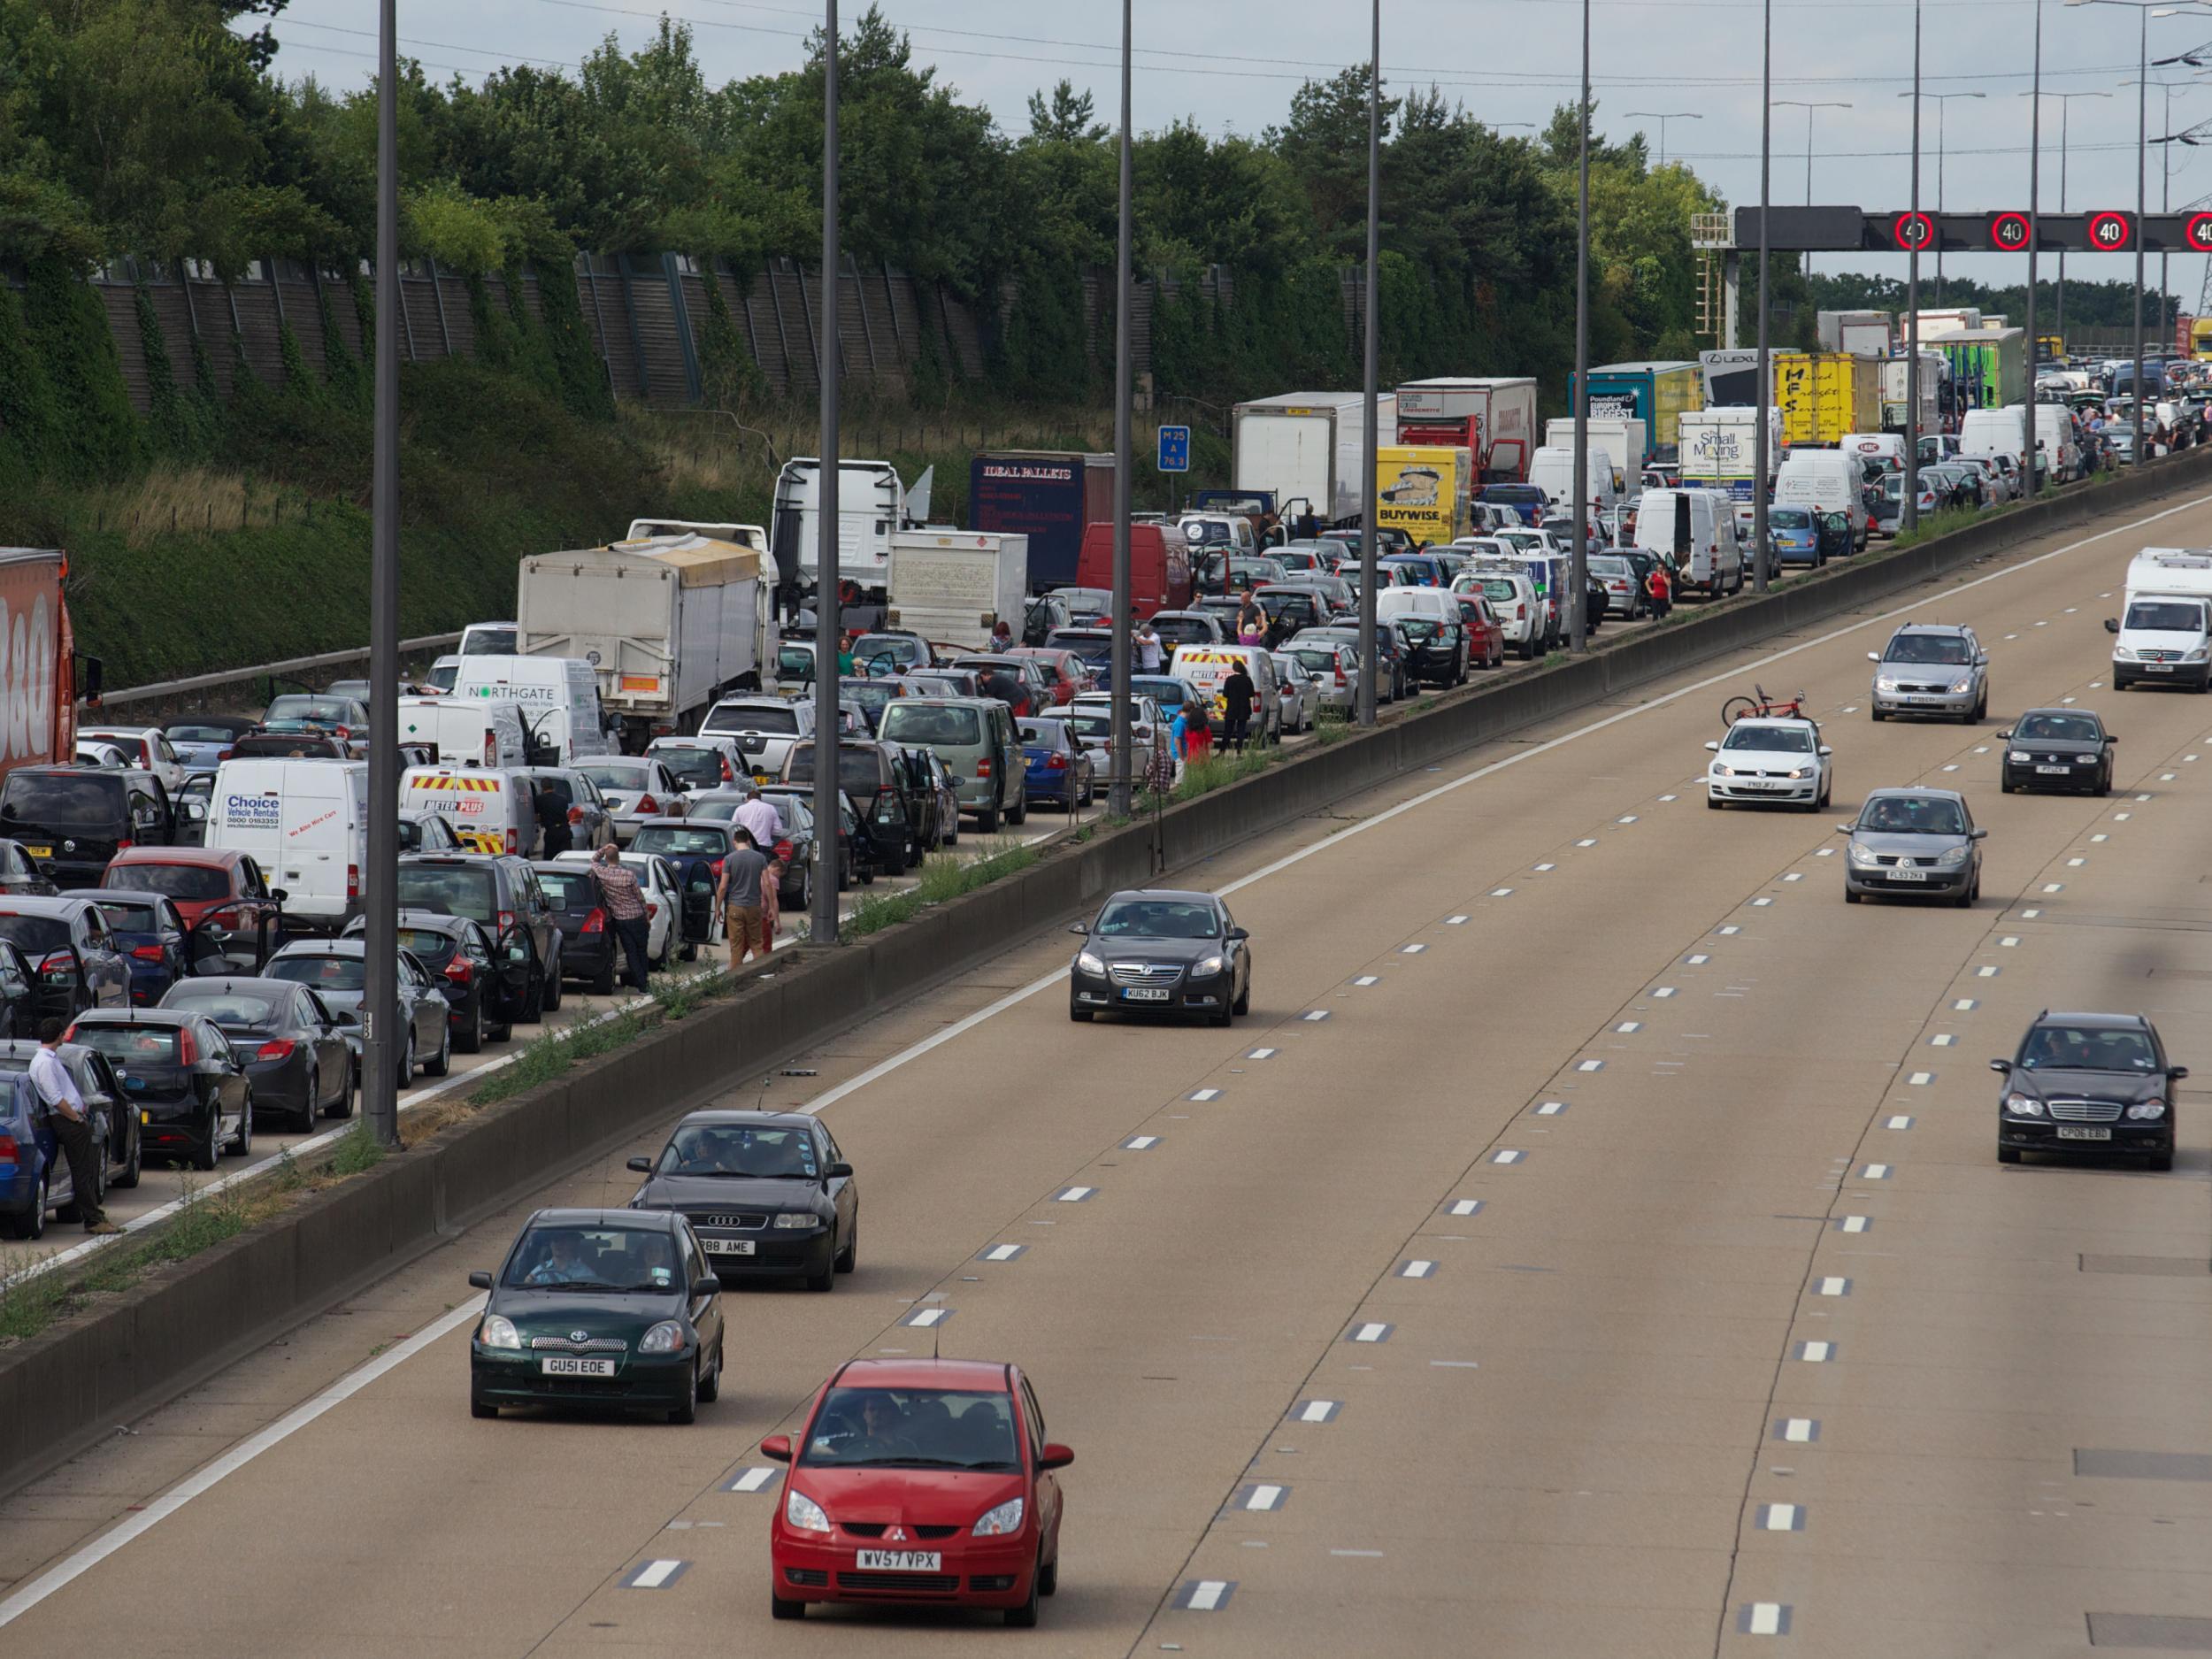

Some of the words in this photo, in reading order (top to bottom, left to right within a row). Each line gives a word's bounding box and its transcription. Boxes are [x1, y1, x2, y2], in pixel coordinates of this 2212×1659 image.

[2002, 223, 2022, 241] 40
[2099, 223, 2120, 241] 40
[1590, 409, 1633, 419] BIGGEST
[1173, 432, 1186, 441] 25
[1701, 432, 1735, 445] Small
[1171, 444, 1177, 453] A
[1694, 443, 1740, 458] Moving
[984, 466, 1020, 477] IDEAL
[1021, 467, 1071, 480] PALLETS
[1380, 510, 1440, 520] BUYWISE
[469, 687, 554, 700] NORTHGATE
[228, 796, 280, 809] Choice
[426, 800, 457, 811] METER
[459, 802, 484, 812] PLUS
[227, 807, 251, 817] Vehicle
[253, 809, 280, 818] Rentals
[1128, 989, 1149, 998] KU62
[726, 1241, 748, 1253] AME
[550, 1360, 578, 1372] GU51
[580, 1361, 605, 1373] EOE
[864, 1551, 902, 1567] WV57
[906, 1553, 934, 1568] VPX
